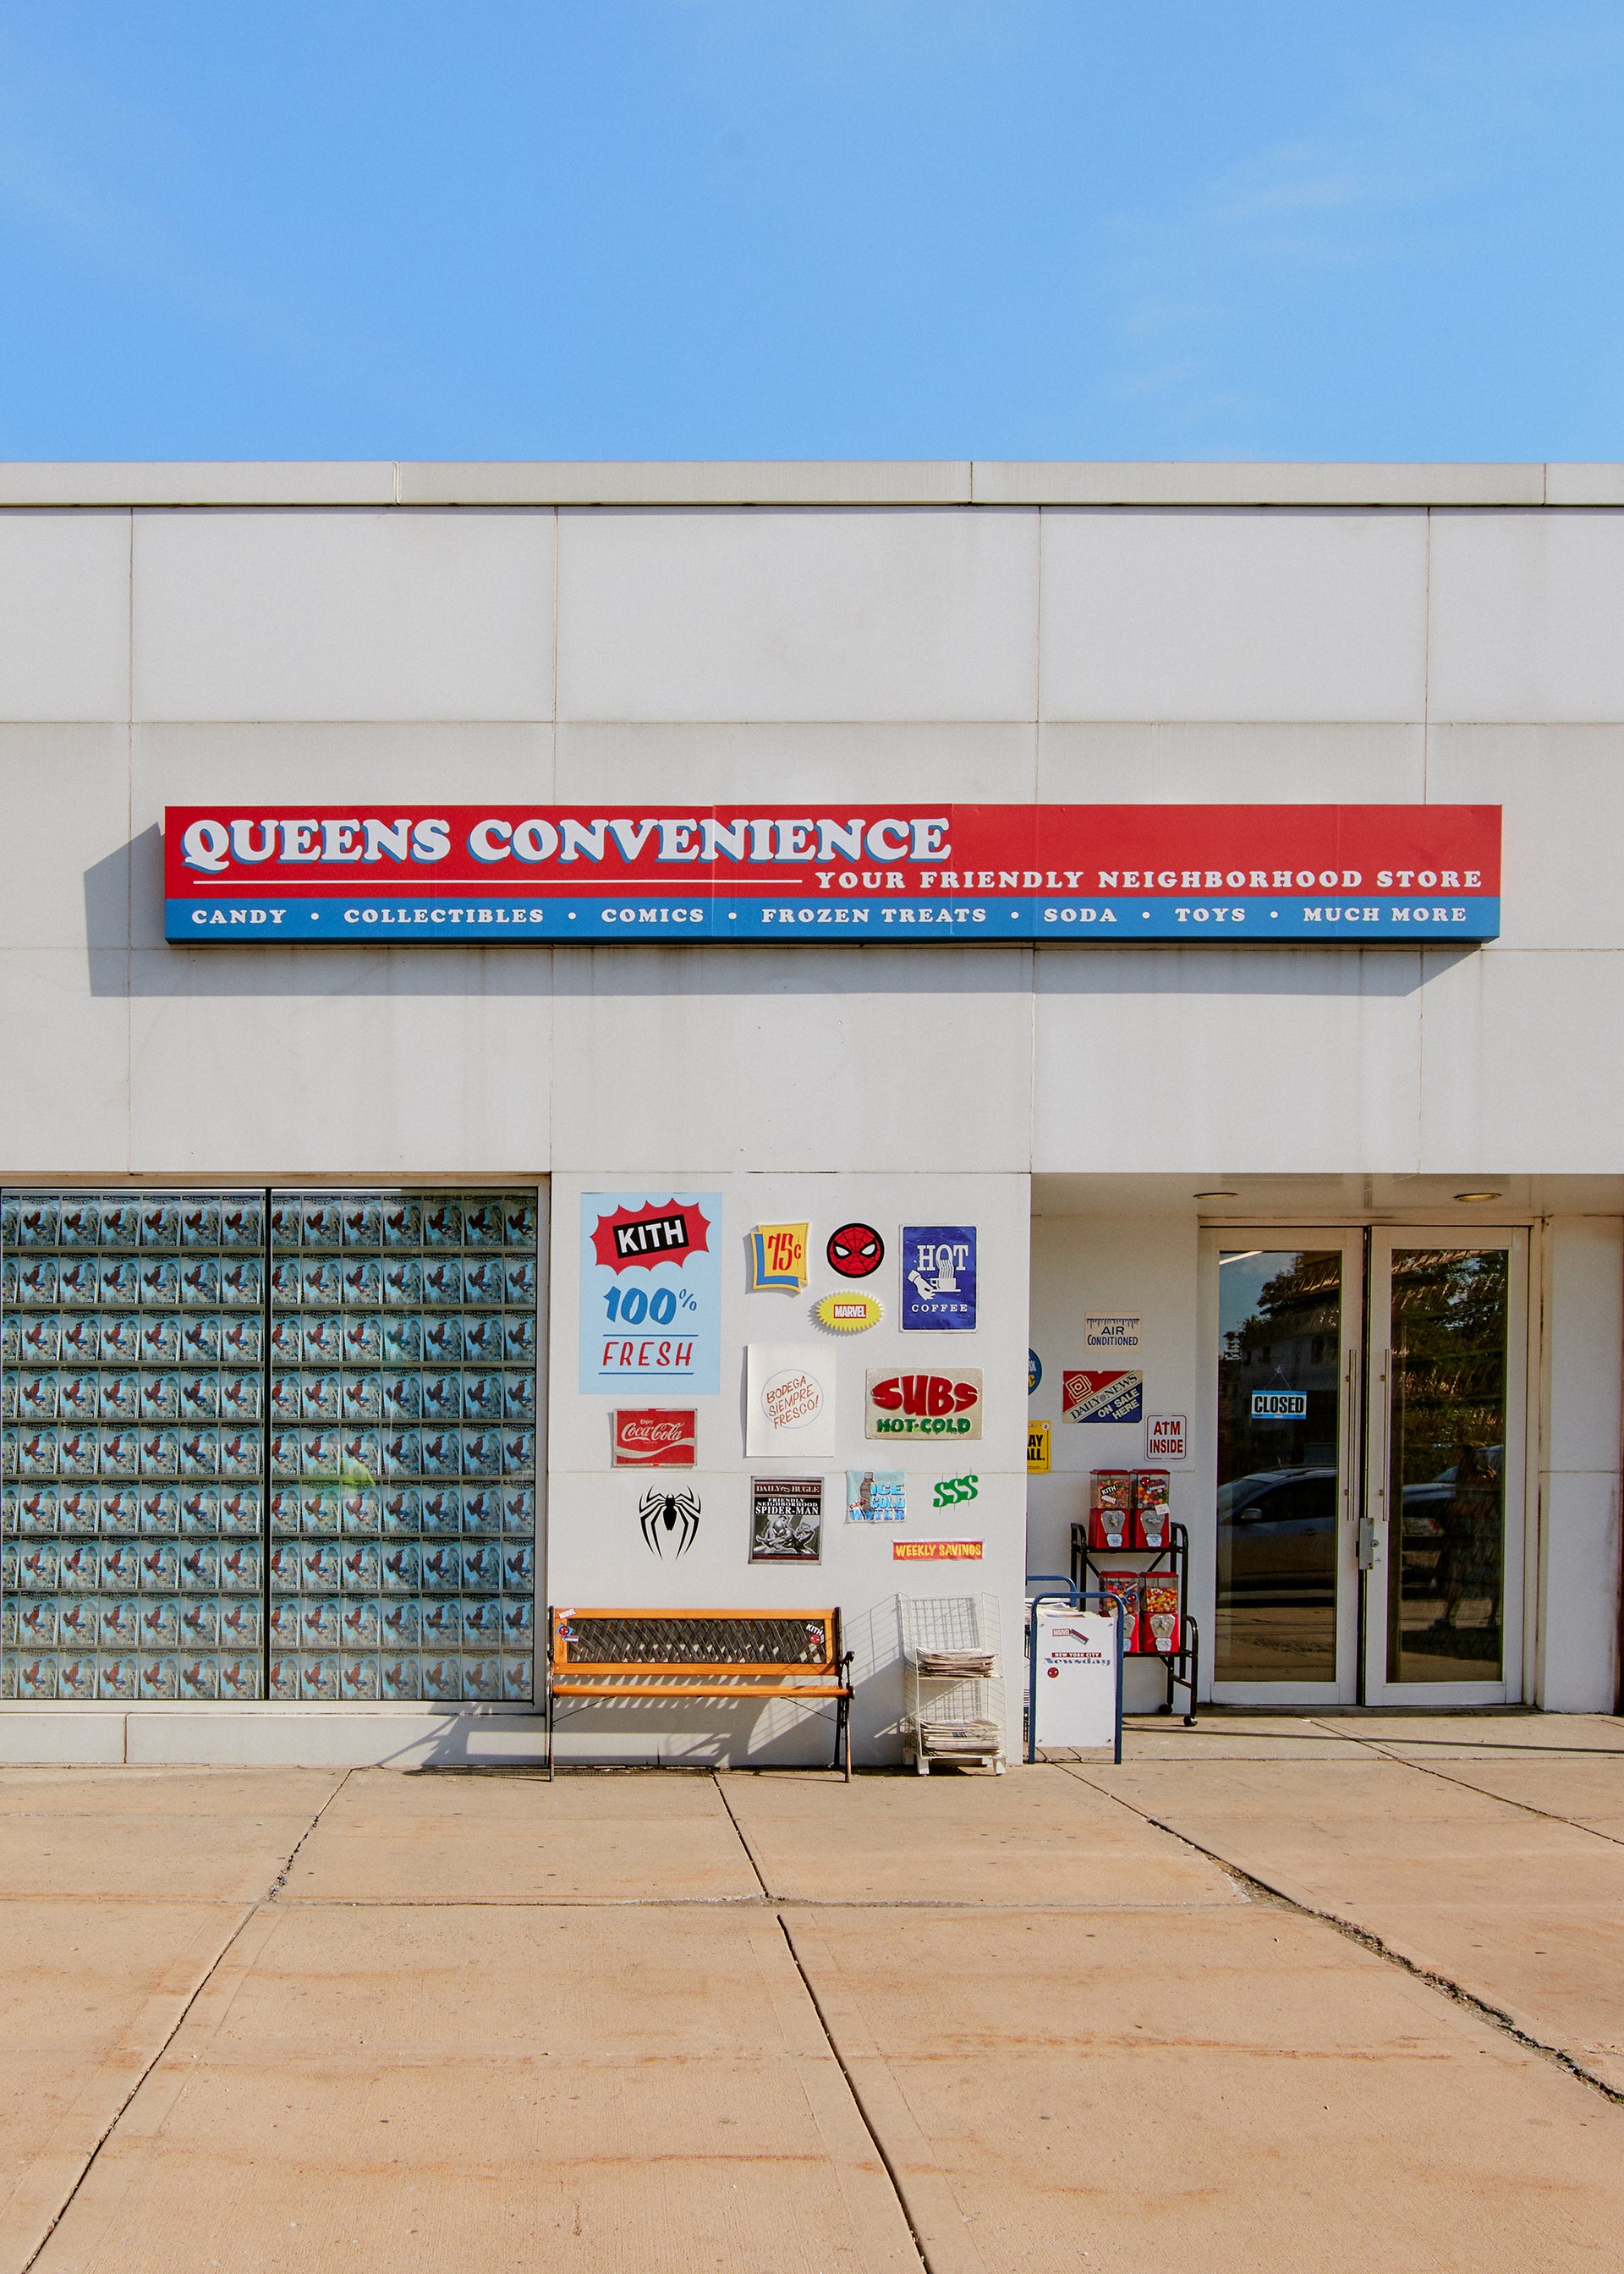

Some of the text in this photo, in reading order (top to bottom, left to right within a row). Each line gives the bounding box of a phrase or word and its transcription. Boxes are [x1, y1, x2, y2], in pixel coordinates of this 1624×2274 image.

[183, 817, 952, 874] QUEENS CONVENIENCE
[815, 871, 1482, 889] YOUR FRIENDLY NEIGHBORHOOD STORE
[191, 909, 287, 924] CANDY
[343, 909, 544, 924] COLLECTIBLES
[601, 908, 704, 923] COMICS
[761, 908, 987, 923] FROZEN TREATS
[1044, 908, 1117, 922] SODA
[1175, 908, 1246, 922] TOYS
[1303, 907, 1467, 922] MUCH MORE
[617, 1219, 684, 1254] KITH
[917, 1244, 968, 1272] HOT
[603, 1286, 698, 1326] 100%
[834, 1305, 866, 1318] MARVEL
[911, 1304, 968, 1312] COFFEE
[1101, 1326, 1125, 1335] AIR
[1087, 1334, 1138, 1346] CONDITIONED
[602, 1341, 694, 1366] FRESH
[766, 1375, 806, 1403] BODEGA
[870, 1375, 979, 1417] SUBS
[1070, 1373, 1138, 1420] DAILY NEWS
[1097, 1388, 1140, 1419] ON SALE
[1112, 1398, 1140, 1420] HERE
[1254, 1396, 1304, 1414] CLOSED
[773, 1394, 820, 1430] FRESCO!
[1153, 1421, 1181, 1436] ATM
[1028, 1434, 1044, 1447] AY
[1149, 1439, 1183, 1453] INSIDE
[870, 1482, 905, 1496] ICE
[1101, 1486, 1116, 1496] KITH
[870, 1496, 906, 1509] COLD
[849, 1509, 905, 1520] WATER
[896, 1543, 982, 1557] WEEKLY SAVINGS
[806, 1623, 824, 1636] KITH
